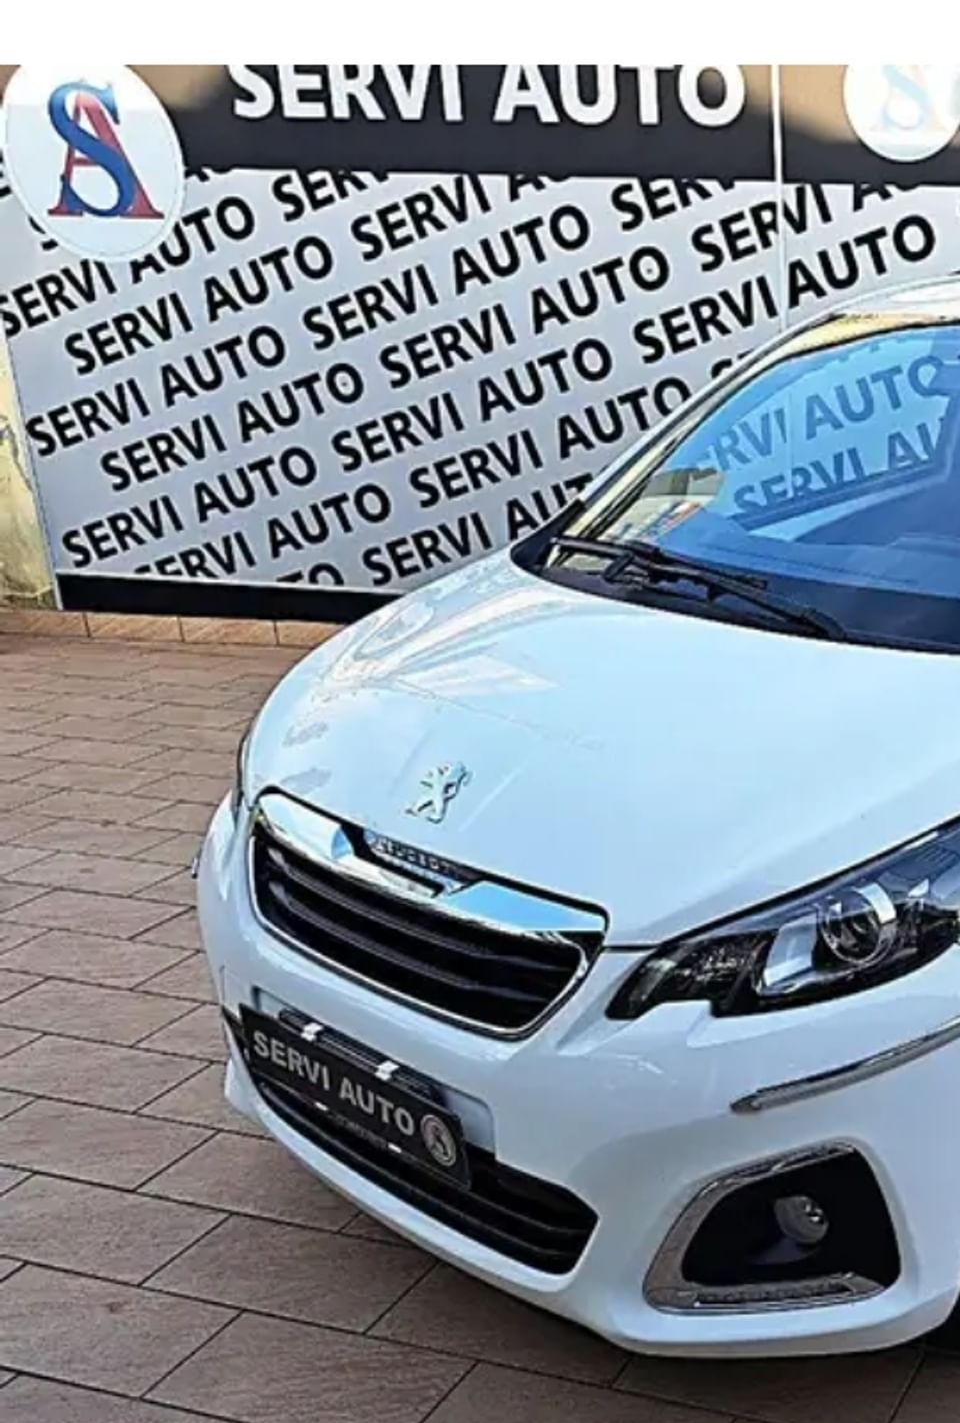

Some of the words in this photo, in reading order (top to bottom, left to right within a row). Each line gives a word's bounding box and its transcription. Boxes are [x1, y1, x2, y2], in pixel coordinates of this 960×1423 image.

[228, 65, 464, 121] SERVI
[493, 65, 746, 127] AUTO
[27, 378, 150, 457] SERVI
[159, 324, 286, 407] AUTO
[303, 264, 439, 350] SERVI
[453, 204, 590, 295] AUTO
[65, 292, 194, 375] SERVI
[204, 235, 333, 321] AUTO
[350, 175, 491, 261] SERVI
[100, 414, 227, 491] SERVI
[236, 362, 365, 443] AUTO
[379, 302, 516, 388] SERVI
[530, 245, 670, 334] AUTO
[691, 183, 832, 272] SERVI
[61, 493, 184, 568] SERVI
[197, 447, 318, 523] AUTO
[331, 393, 465, 472] SERVI
[479, 338, 613, 423] AUTO
[632, 275, 778, 364] SERVI
[787, 214, 935, 309] AUTO
[134, 531, 256, 578] ERVI
[267, 483, 391, 559] AUTO
[410, 430, 543, 511] SERVI
[557, 377, 692, 459] AUTO
[362, 512, 492, 586] SERVI
[253, 1030, 331, 1091] SERVI
[339, 1076, 415, 1137] AUTO
